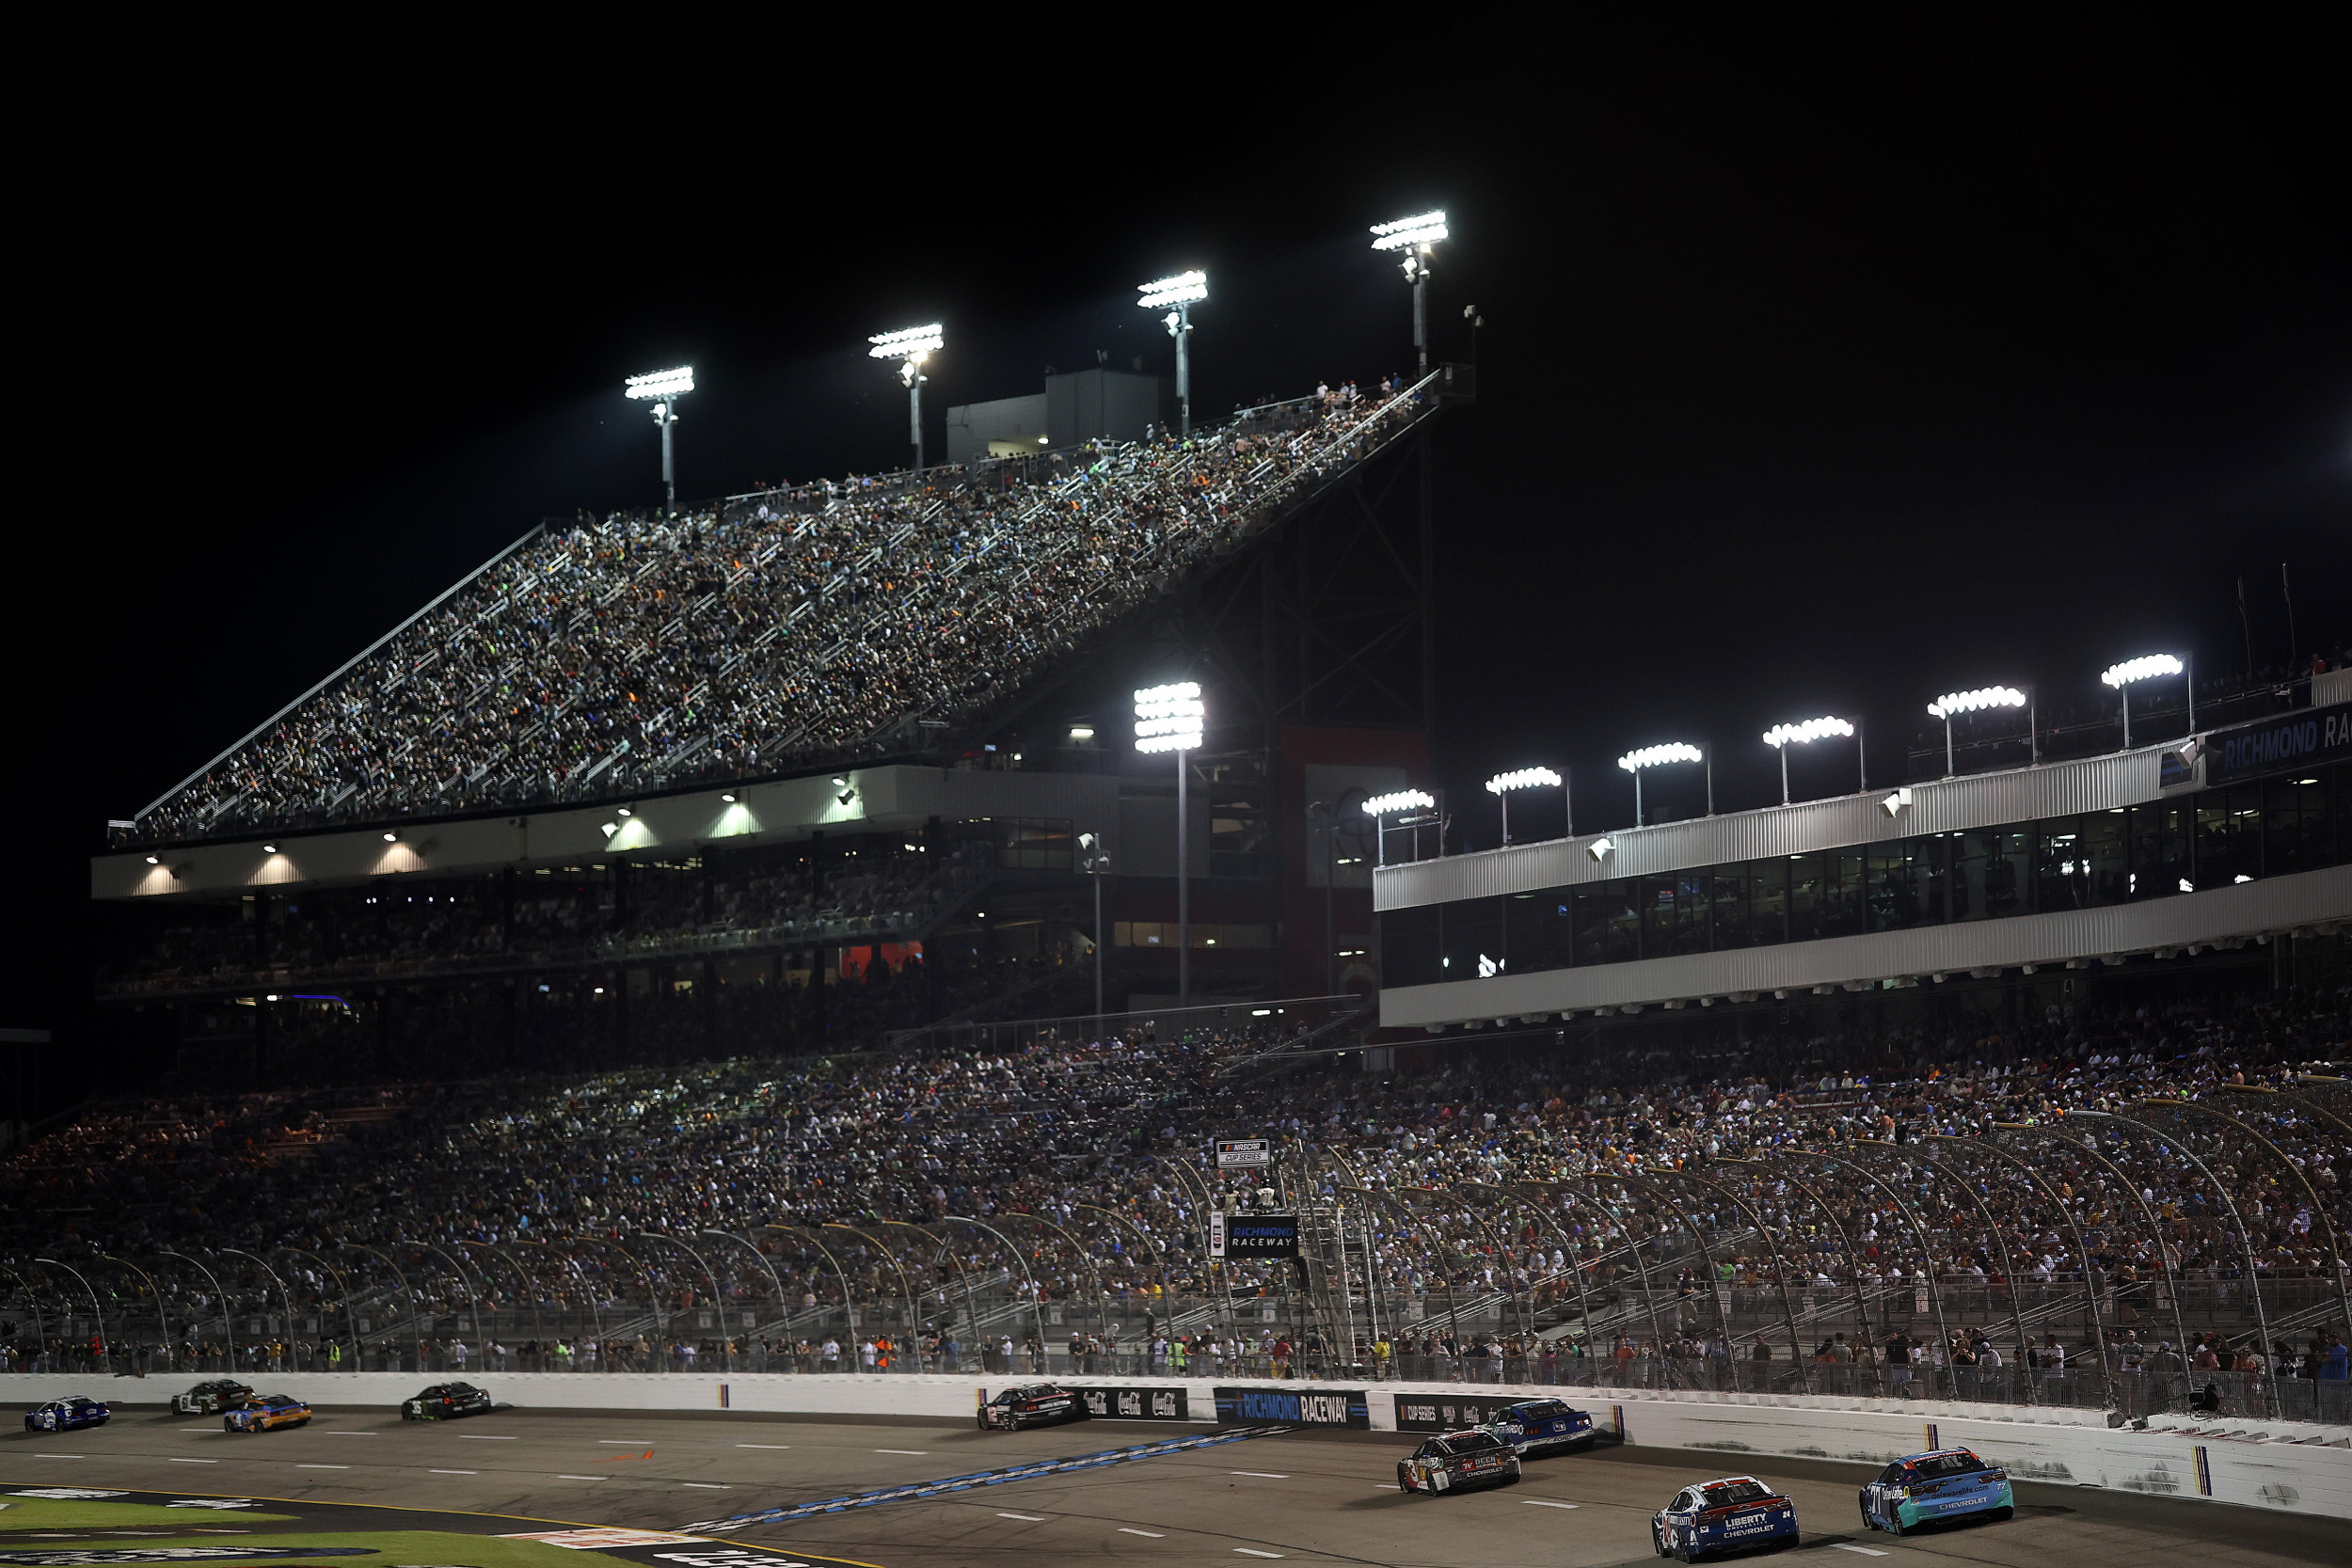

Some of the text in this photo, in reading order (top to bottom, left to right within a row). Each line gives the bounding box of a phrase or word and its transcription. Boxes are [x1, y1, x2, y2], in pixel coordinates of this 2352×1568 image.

[2224, 712, 2352, 770] RICHMOND RA
[1233, 1143, 1261, 1151] NASCAR
[1233, 1227, 1294, 1237] RICHMOND
[1232, 1238, 1293, 1246] RACEWAY
[1243, 1393, 1347, 1423] RICHMOND RACEWAY
[1407, 1405, 1418, 1420] CUP
[1418, 1405, 1437, 1421] SERIES
[1553, 1434, 1572, 1443] FORD
[1407, 1459, 1419, 1482] 3
[1467, 1467, 1503, 1478] CHEVROLET
[1931, 1484, 1989, 1499] delawarelife.com
[1996, 1481, 2006, 1491] 77
[1870, 1485, 1881, 1515] 77
[1939, 1497, 1988, 1511] CHEVROLET
[1724, 1513, 1767, 1528] LIBERTY
[1783, 1511, 1790, 1519] 24
[1724, 1524, 1775, 1539] CHEVROLET
